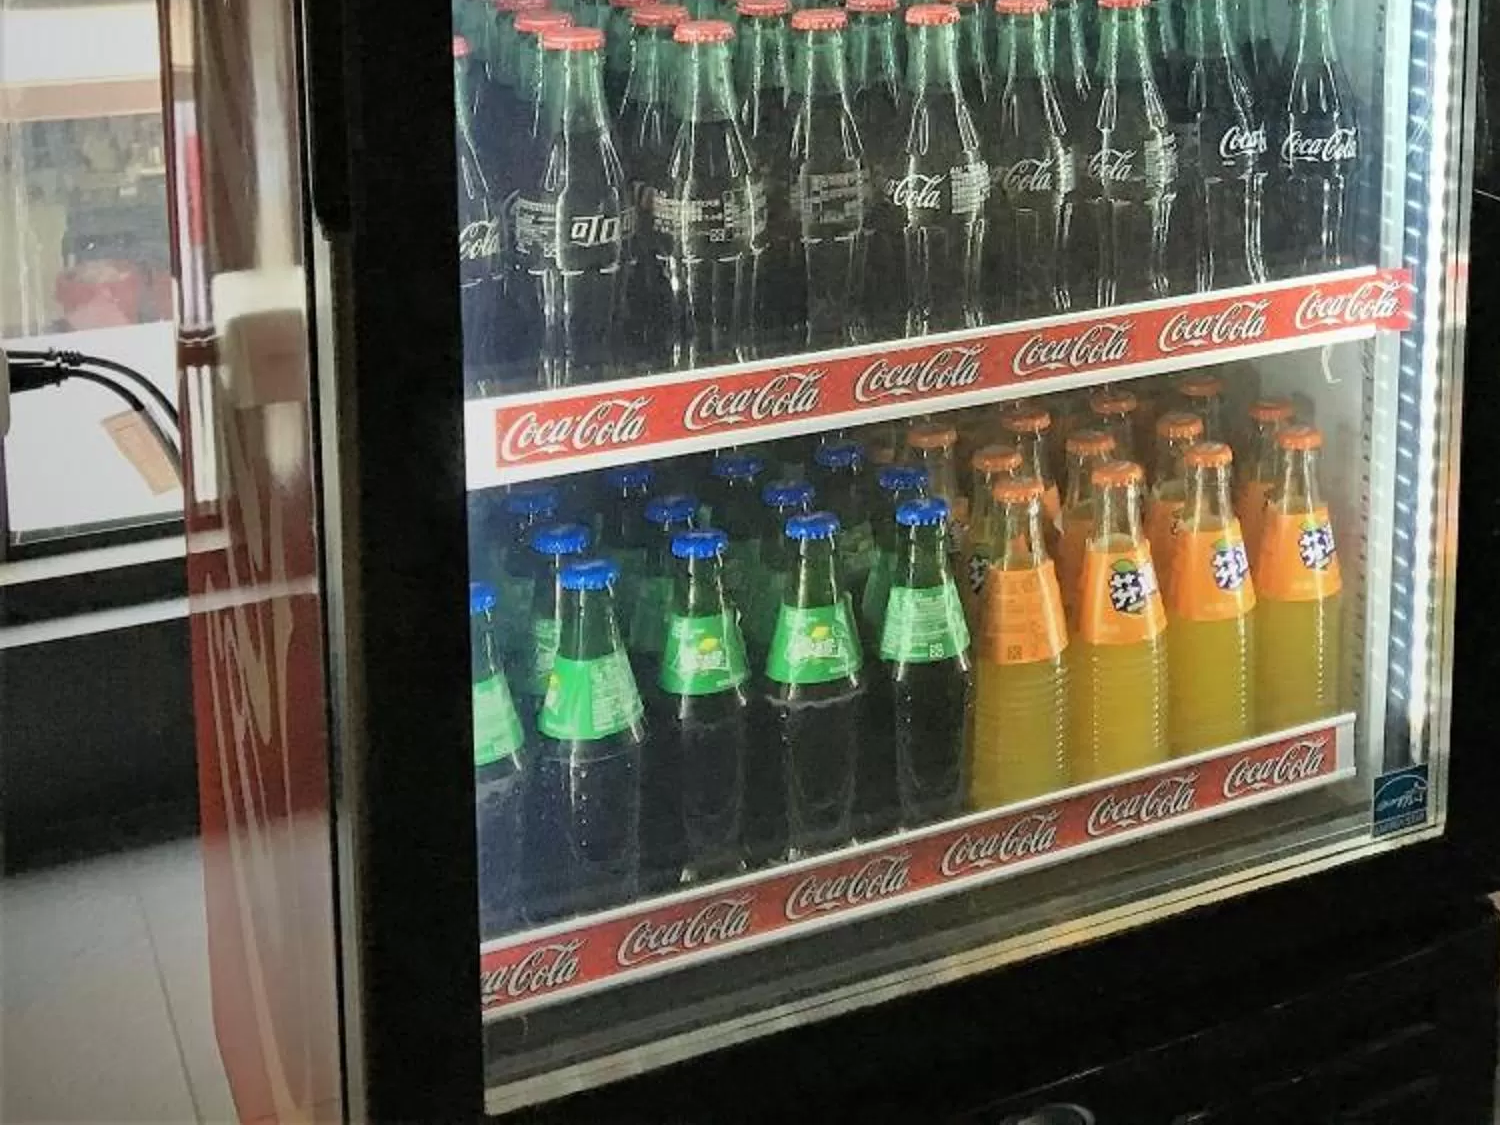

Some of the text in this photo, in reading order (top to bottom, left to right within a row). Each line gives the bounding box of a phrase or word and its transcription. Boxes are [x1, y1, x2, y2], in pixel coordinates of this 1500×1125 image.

[501, 278, 1402, 462] Coca-Cola Coca-Cola Coca-Cola Coca-Cola Coca-Cola Coca-Cola
[616, 893, 757, 966] Coca-Cola
[785, 851, 912, 920] Coca-Cola
[940, 808, 1064, 876] Coca-Cola
[1087, 772, 1199, 836] Coca-Cola
[1223, 736, 1329, 797] Coca-Cola
